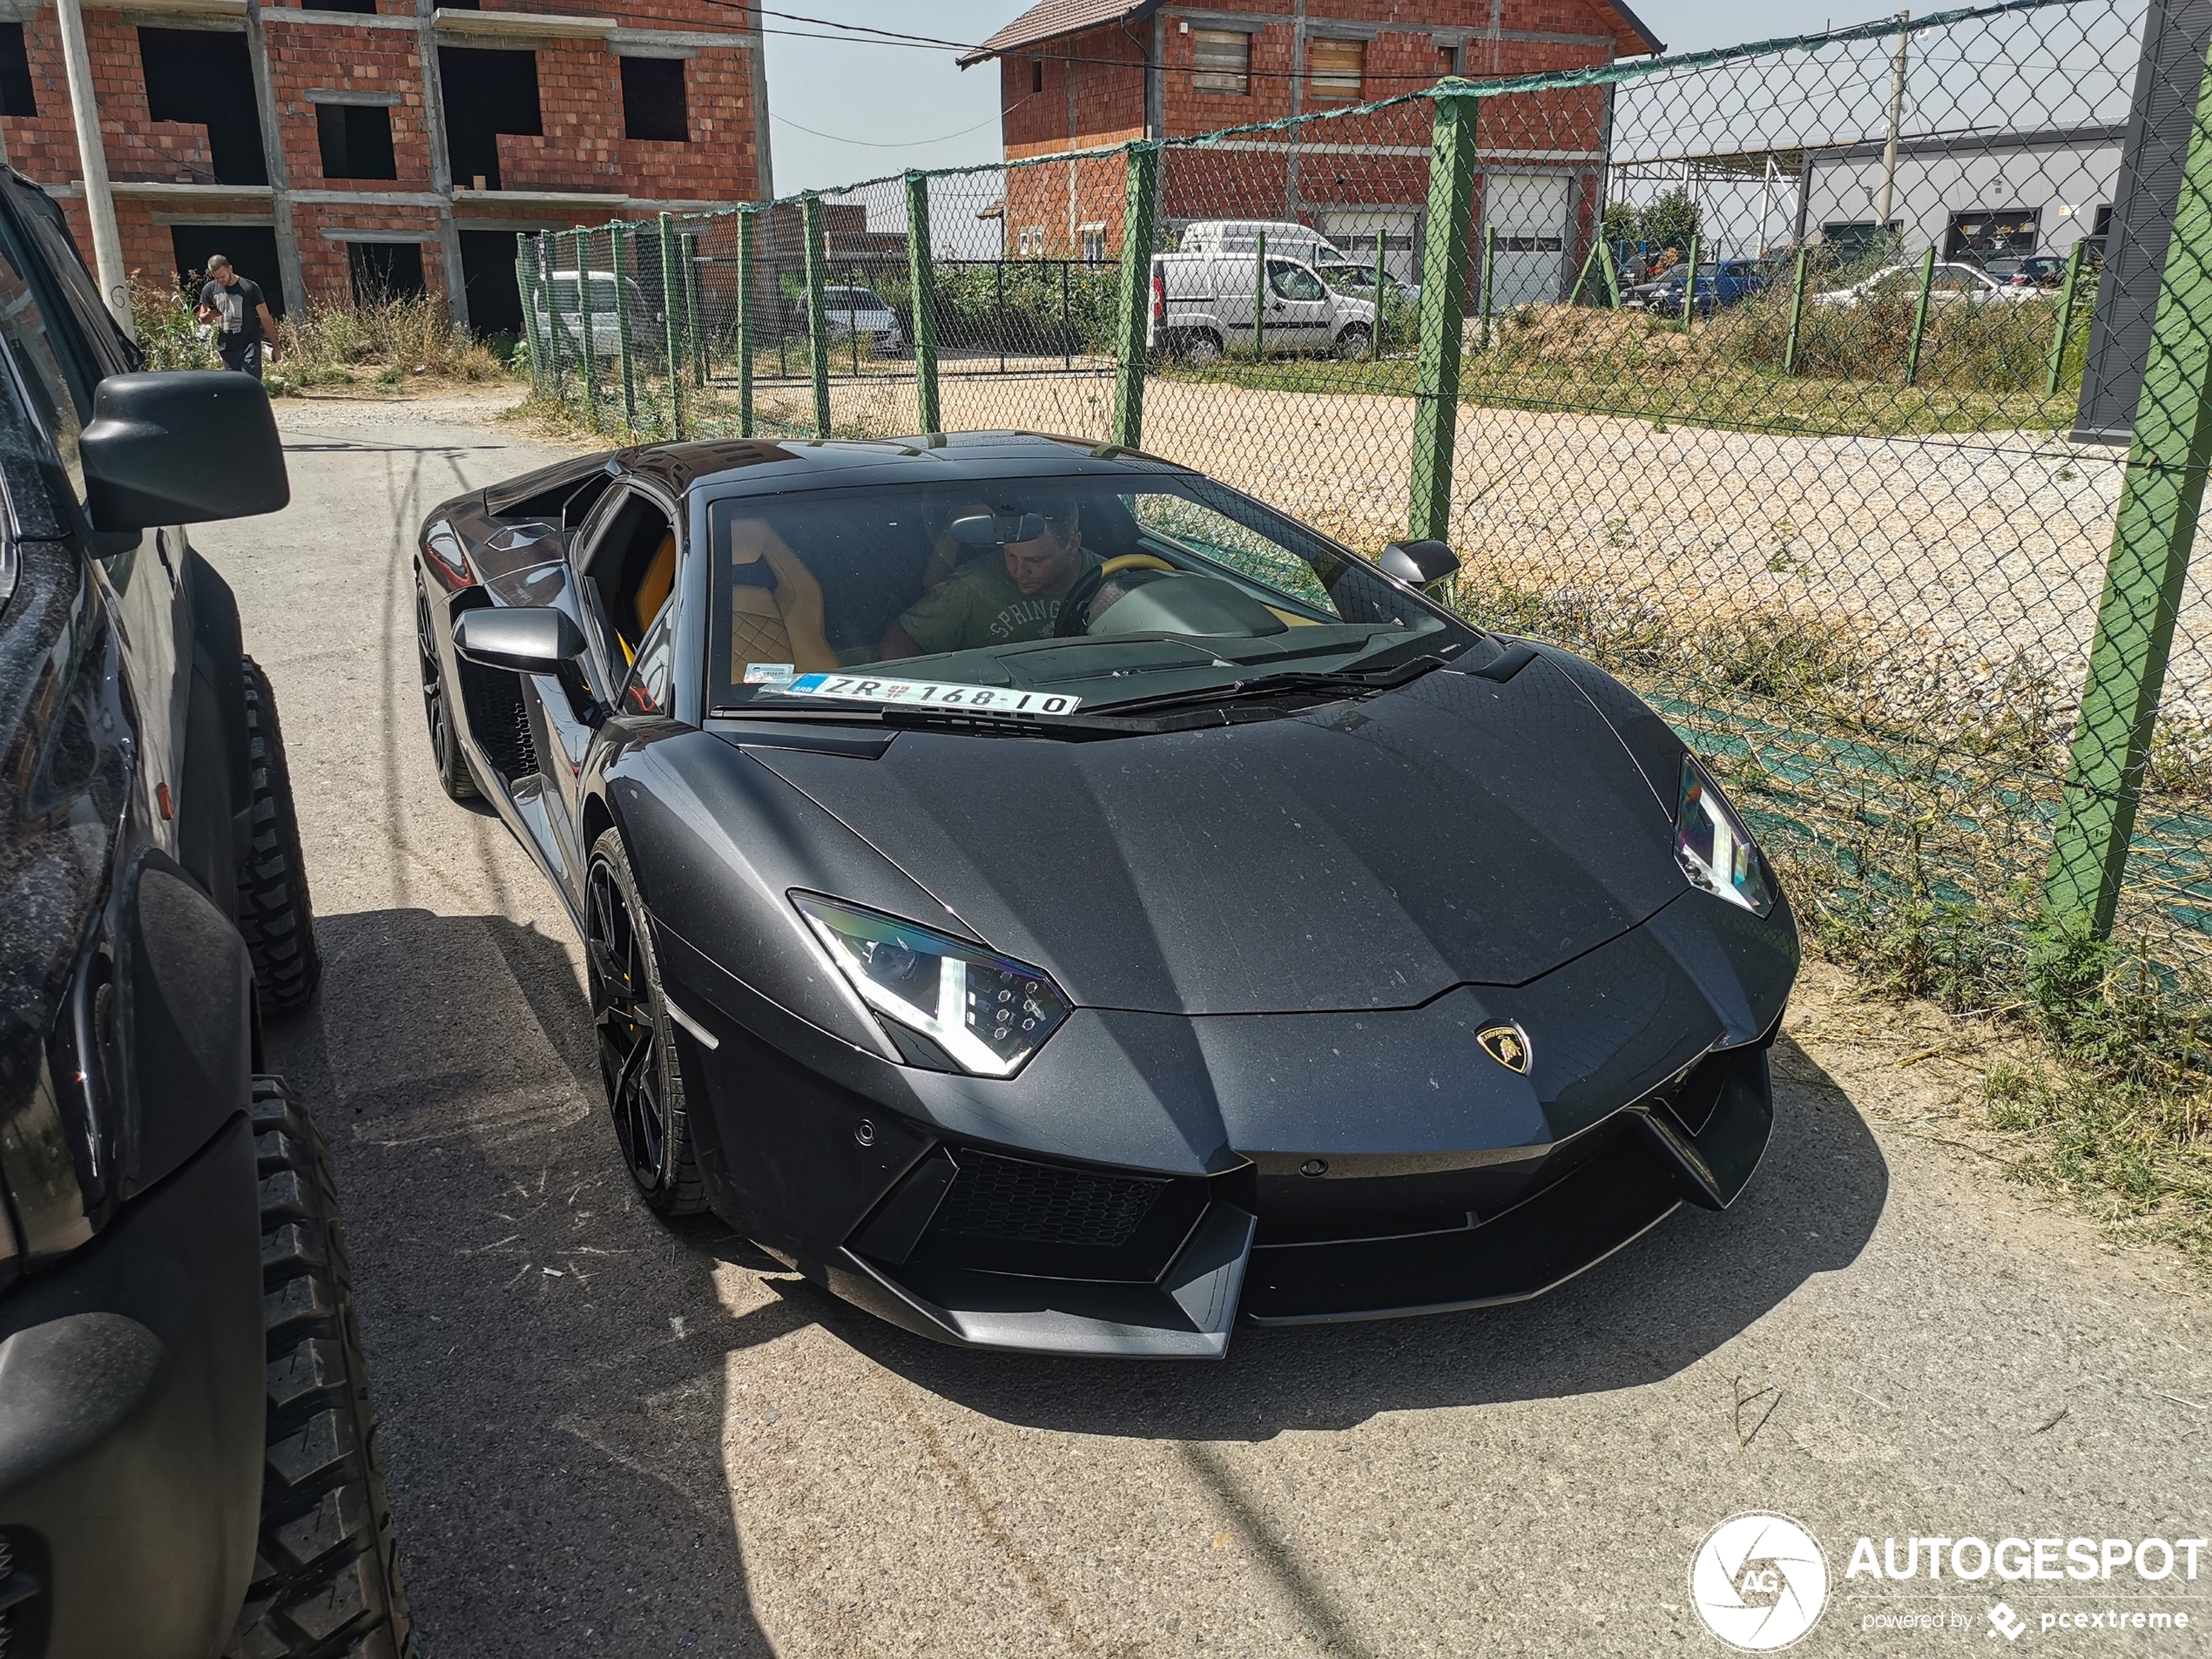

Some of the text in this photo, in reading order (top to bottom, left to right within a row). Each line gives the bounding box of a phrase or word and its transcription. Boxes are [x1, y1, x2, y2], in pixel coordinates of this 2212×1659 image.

[111, 285, 125, 308] 6
[989, 599, 1061, 638] SPRING
[824, 678, 881, 696] ZR
